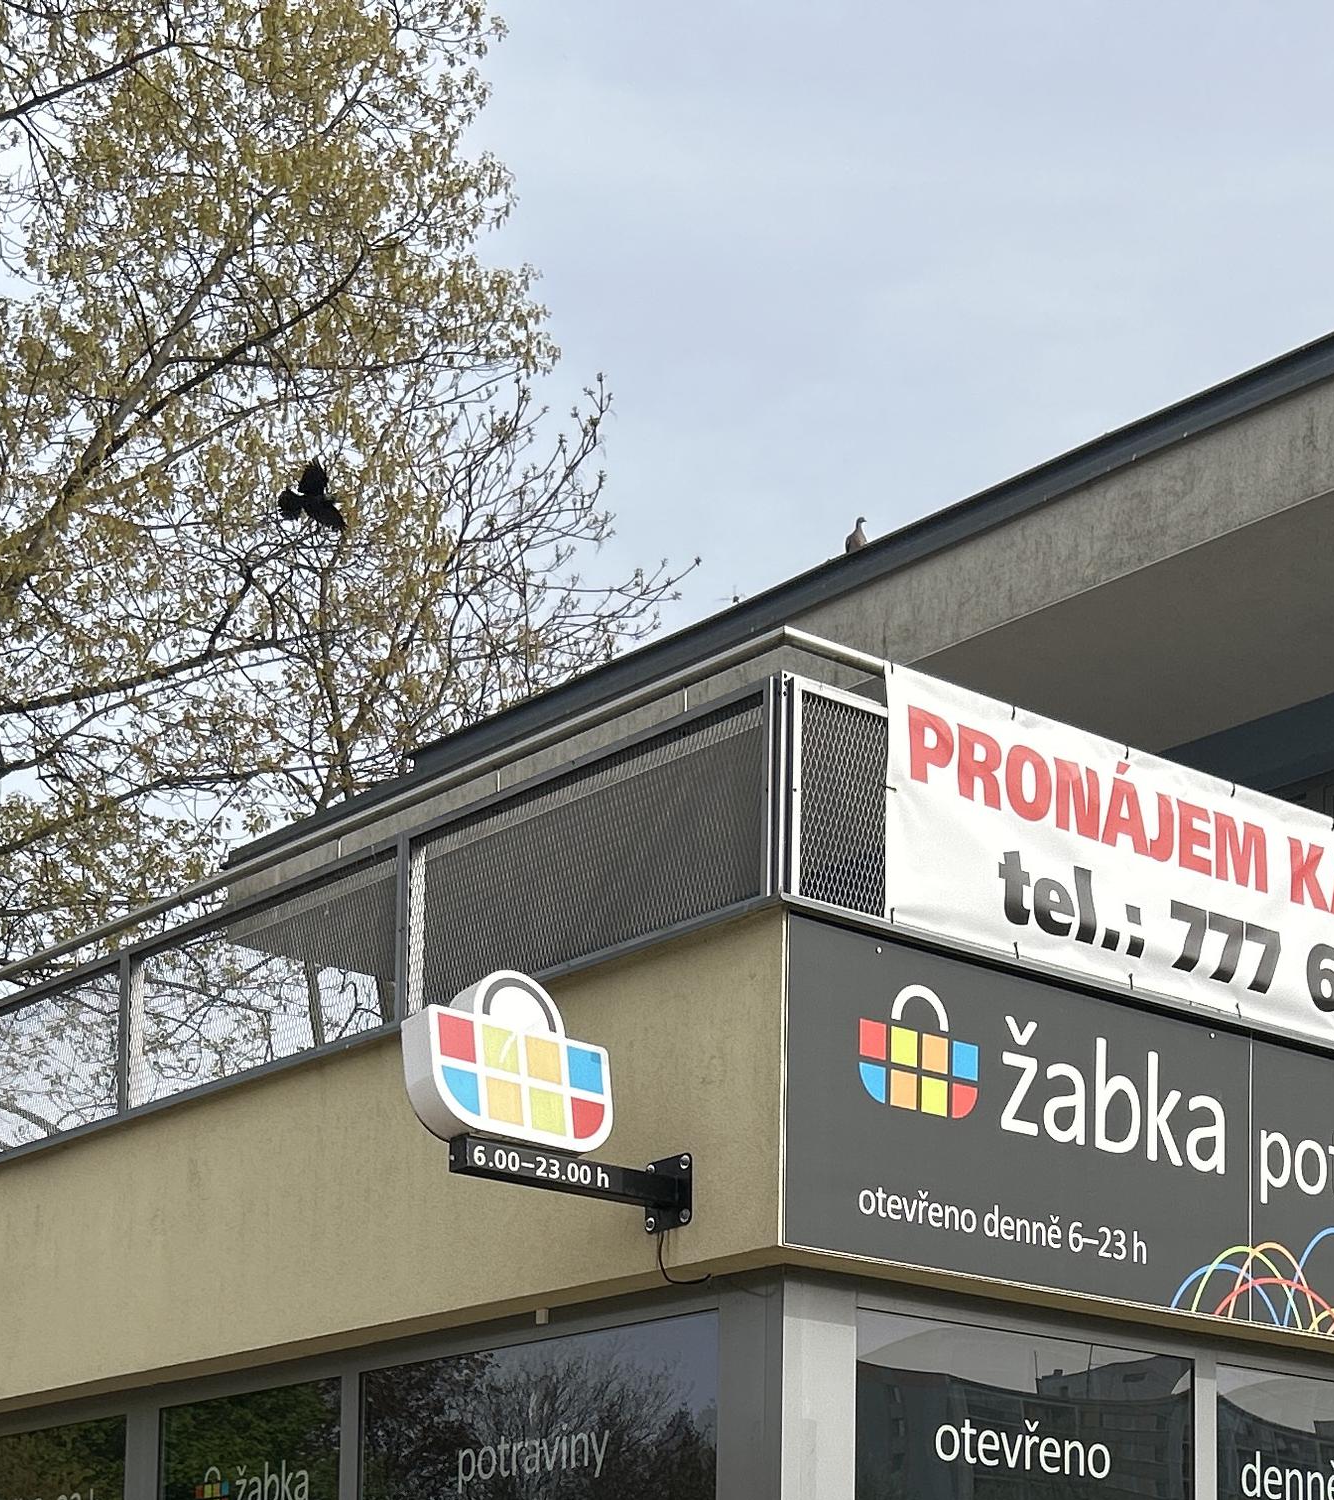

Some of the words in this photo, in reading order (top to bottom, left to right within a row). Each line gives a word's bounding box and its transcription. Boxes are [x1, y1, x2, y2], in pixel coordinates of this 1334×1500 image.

[907, 704, 1268, 894] PRONÁJEM
[998, 850, 1145, 959] tel.:
[1170, 899, 1282, 994] 777
[1000, 1015, 1226, 1175] žabka
[596, 1166, 610, 1189] h
[858, 1186, 977, 1234] otevřeno
[983, 1204, 1062, 1249] denně
[1068, 1220, 1127, 1261] 6–23
[1132, 1230, 1147, 1264] h
[457, 1424, 611, 1494] potraviny
[935, 1418, 1112, 1479] otevřeno
